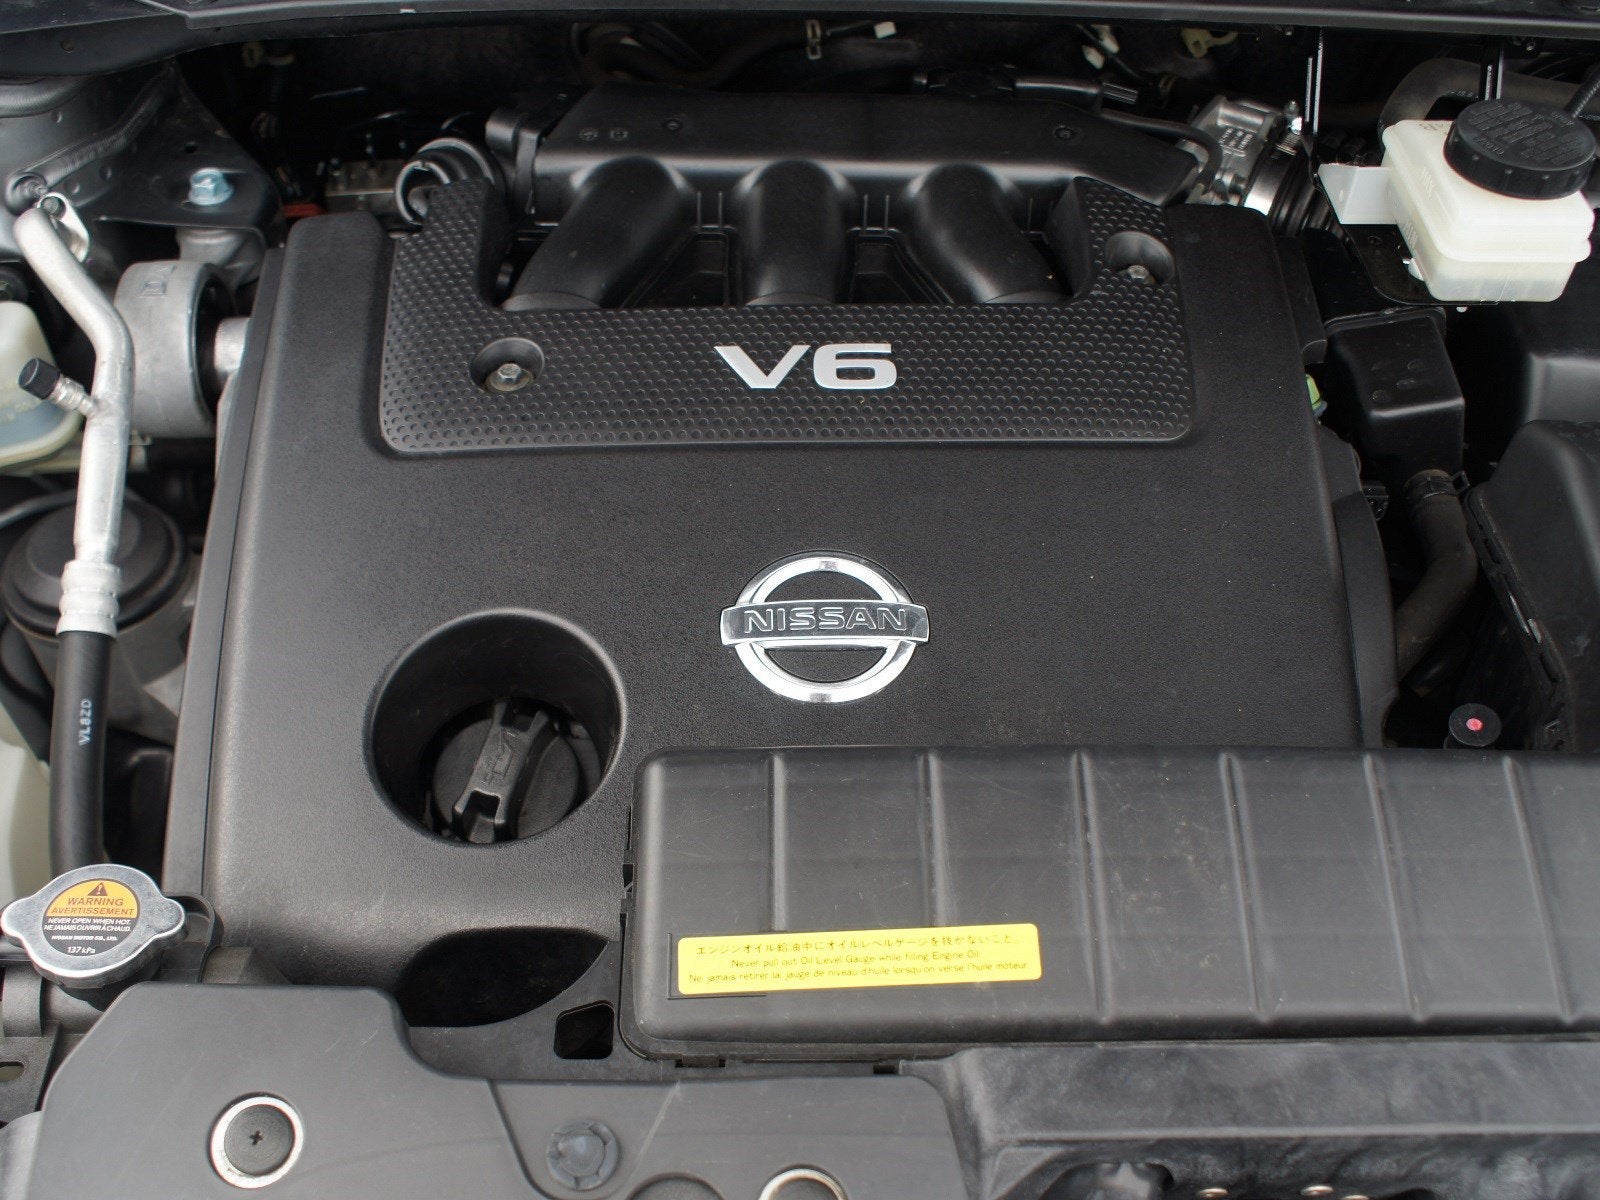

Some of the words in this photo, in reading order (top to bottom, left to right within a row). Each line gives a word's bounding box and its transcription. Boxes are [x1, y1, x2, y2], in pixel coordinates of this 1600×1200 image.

[714, 343, 898, 390] V6
[744, 607, 907, 633] NISSAN
[51, 907, 135, 916] AVERTISSEMENT
[67, 897, 124, 907] WARNING
[67, 946, 82, 954] 137
[731, 959, 759, 968] Never
[763, 958, 779, 969] pull
[782, 957, 797, 966] out
[800, 955, 813, 965] Oil
[816, 955, 843, 965] Level
[846, 954, 875, 965] Gauge
[879, 953, 901, 962] while
[905, 951, 929, 962] filling
[932, 950, 963, 962] Engine
[689, 973, 702, 983] Ne
[707, 973, 736, 985] jamais
[739, 970, 769, 980] retirer
[772, 970, 781, 979] la
[785, 970, 810, 981] jauge
[814, 967, 825, 977] de
[828, 967, 859, 976] niveau
[939, 963, 964, 973] verse
[996, 960, 1028, 971] moteur
